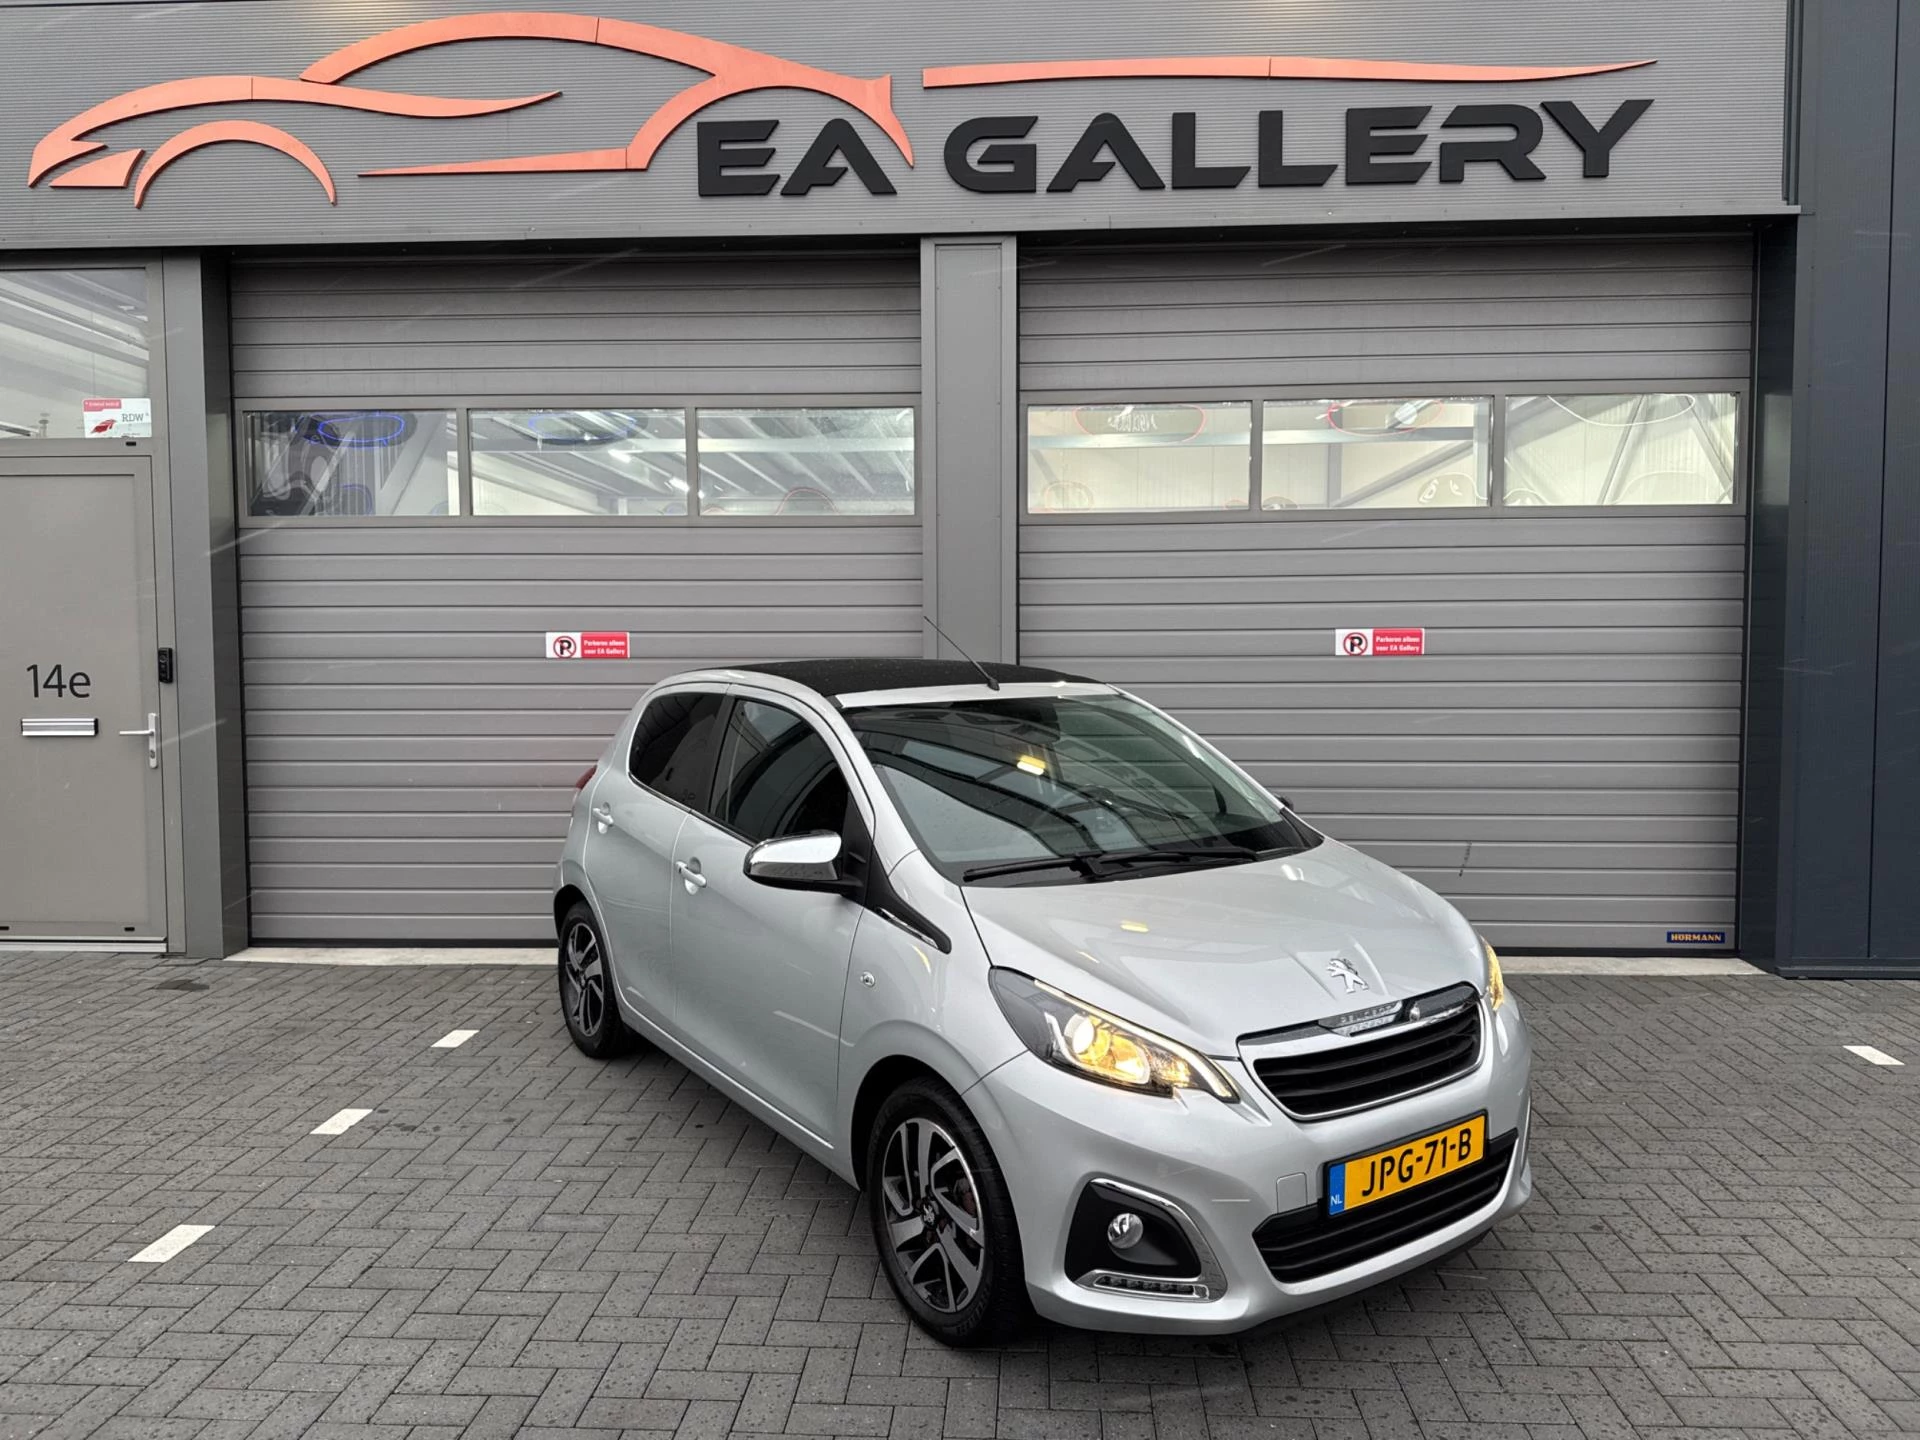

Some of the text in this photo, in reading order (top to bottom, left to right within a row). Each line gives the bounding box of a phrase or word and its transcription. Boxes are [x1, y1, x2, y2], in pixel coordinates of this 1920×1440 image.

[697, 99, 1655, 197] EA GALLERY
[121, 413, 144, 422] RDW
[26, 663, 91, 699] 14e
[1362, 1128, 1472, 1197] JPG-71-B
[1330, 1194, 1343, 1206] NL
